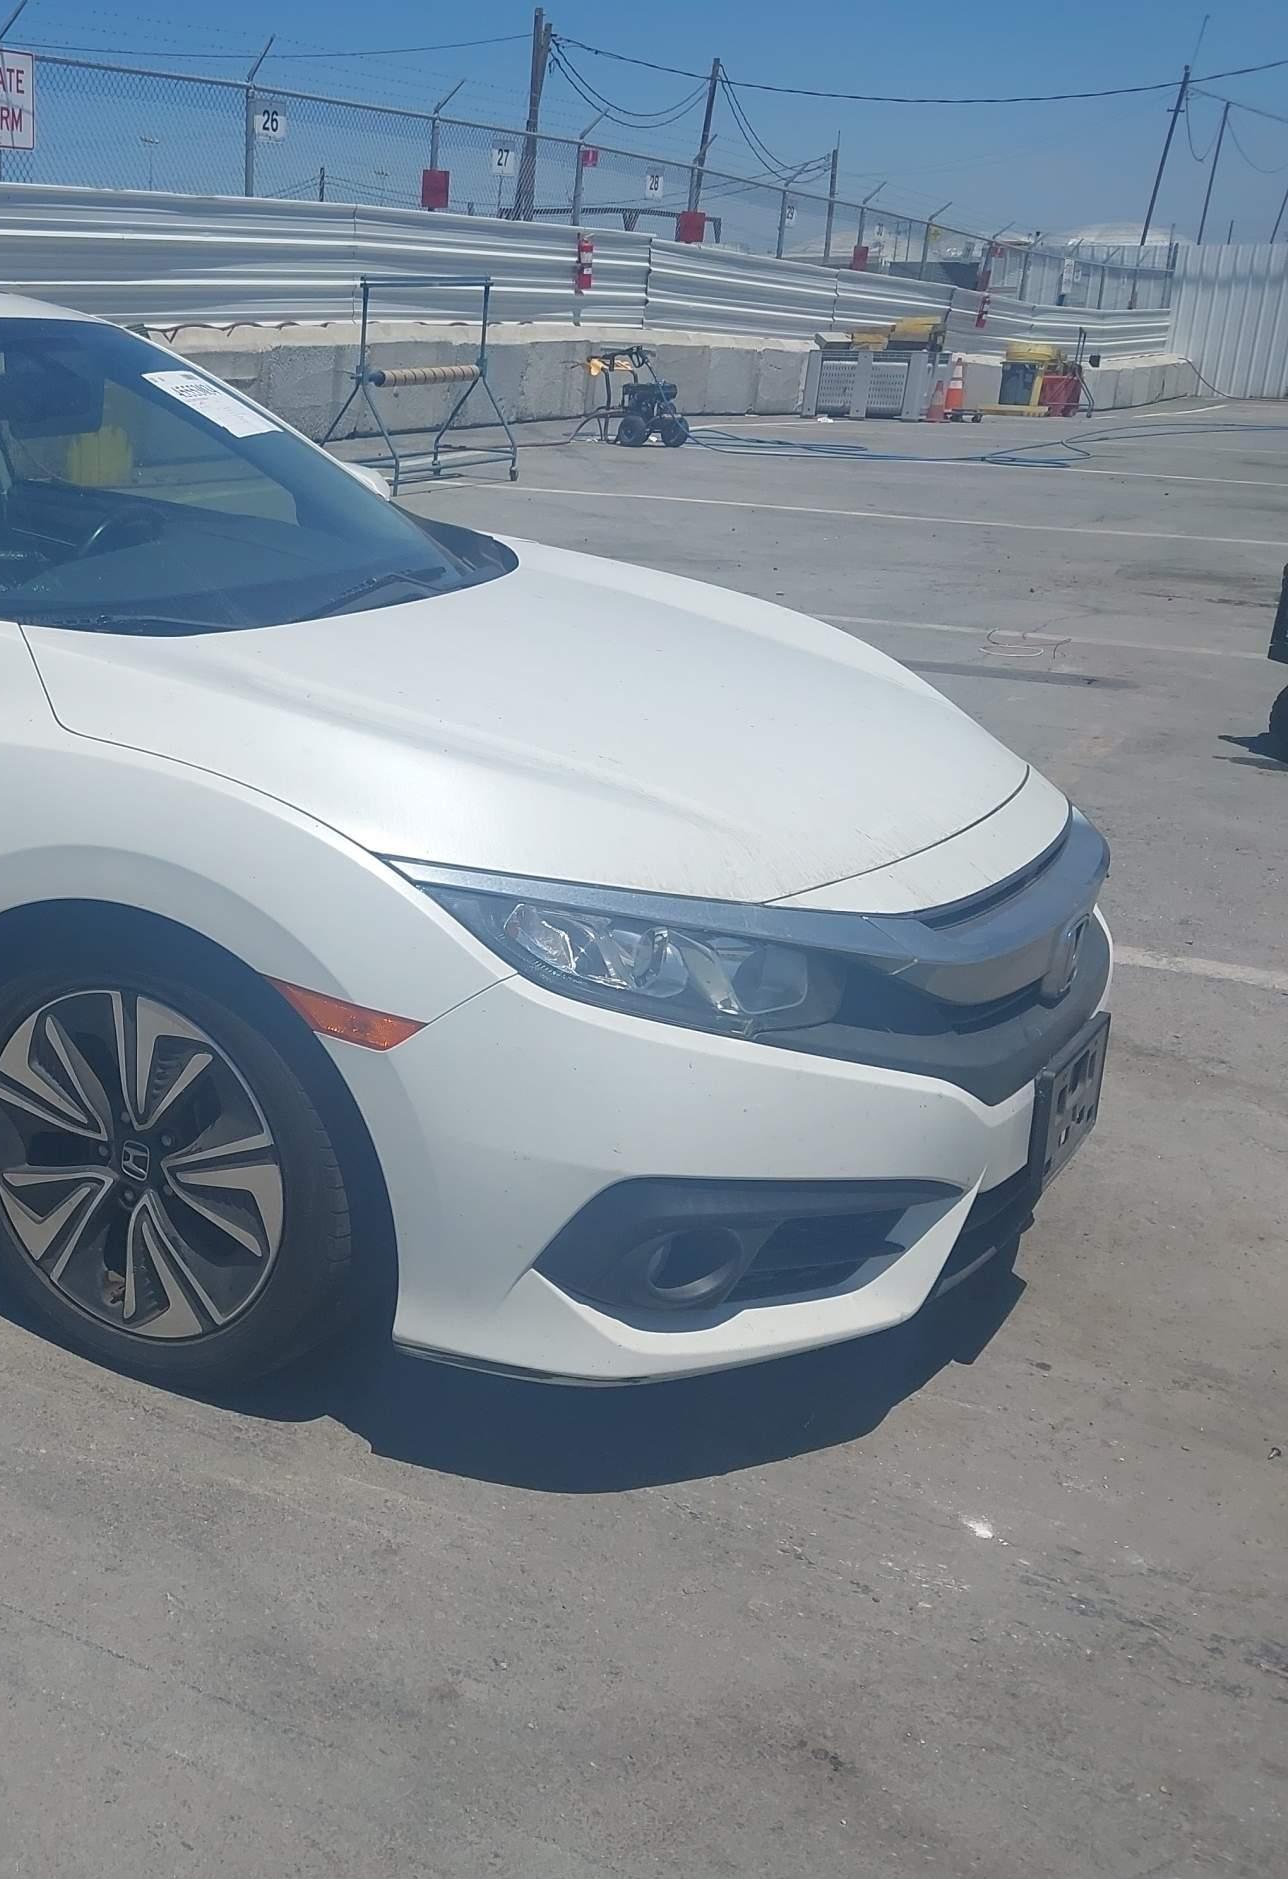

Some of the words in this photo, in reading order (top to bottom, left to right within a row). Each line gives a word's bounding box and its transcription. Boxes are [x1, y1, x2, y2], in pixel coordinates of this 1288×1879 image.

[262, 110, 279, 132] 26
[497, 148, 510, 168] 27
[649, 175, 659, 191] 28
